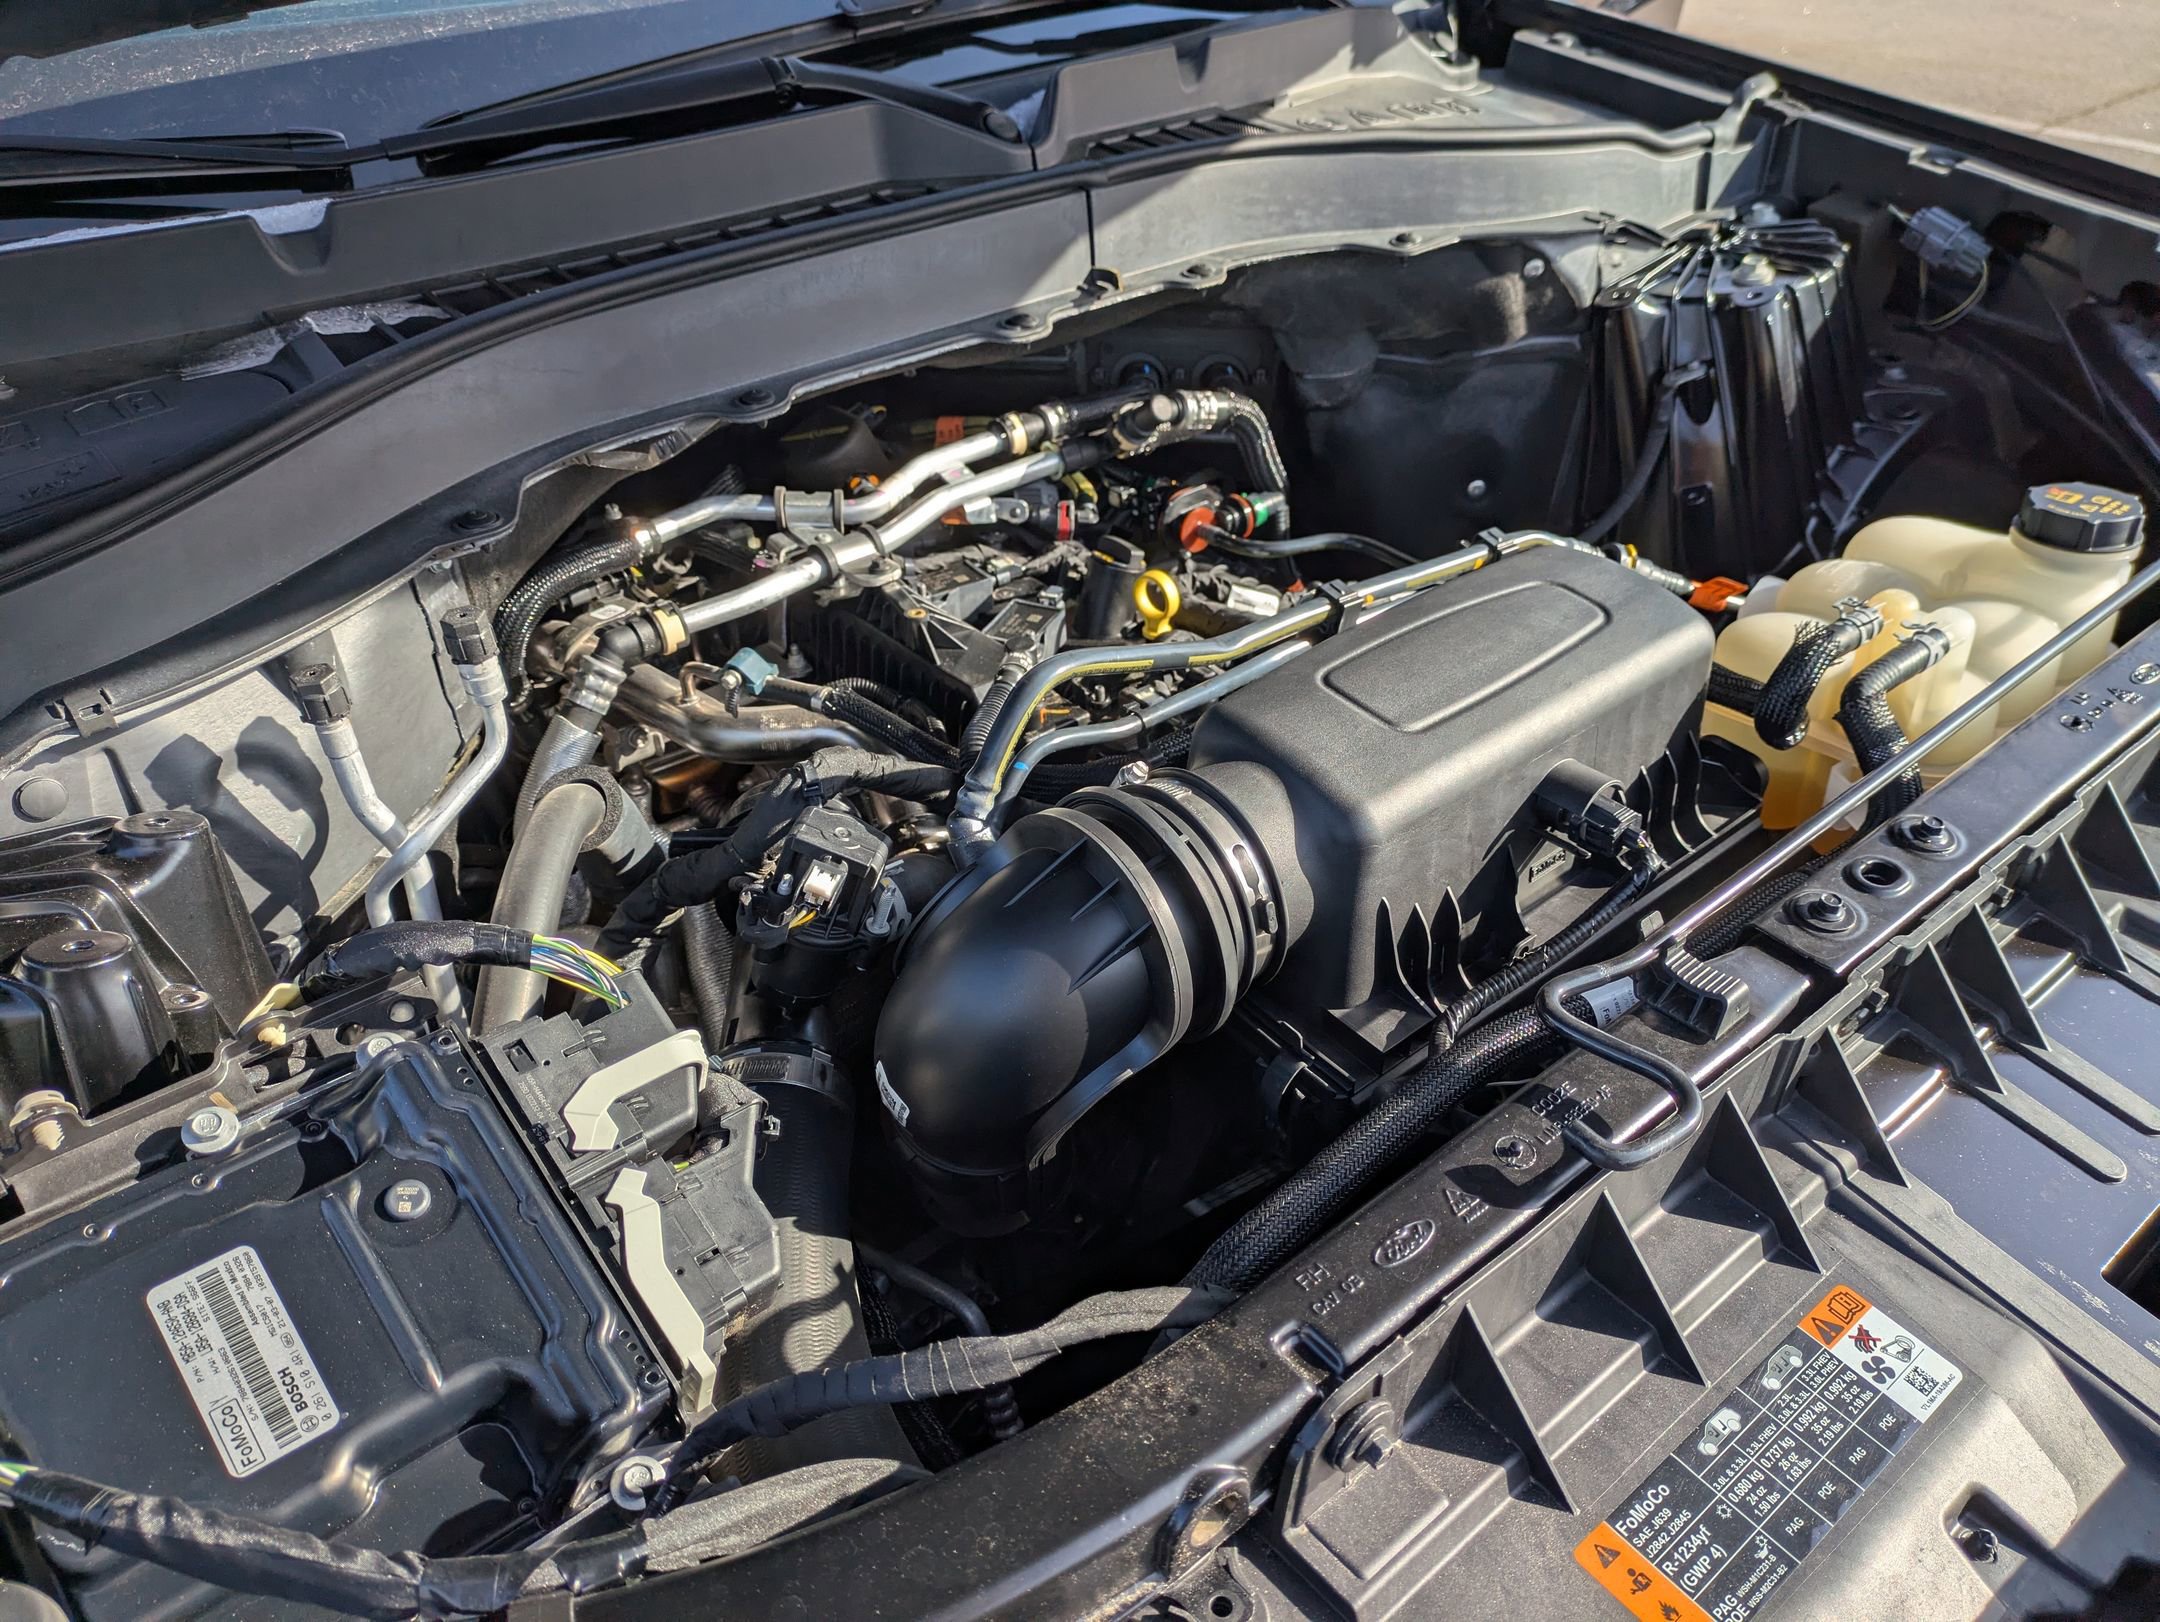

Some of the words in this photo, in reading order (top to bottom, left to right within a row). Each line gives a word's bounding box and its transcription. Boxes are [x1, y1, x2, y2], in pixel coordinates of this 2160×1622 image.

[220, 1259, 238, 1284] Mexico
[236, 1290, 259, 1327] Assembled
[1801, 1366, 1817, 1382] 3.3L
[1812, 1351, 1831, 1370] FHEV
[1809, 1373, 1825, 1389] 3.0L
[1820, 1357, 1840, 1376] PHEV
[276, 1365, 308, 1413] BOSCH
[1822, 1377, 1847, 1401] 0.992
[1840, 1369, 1858, 1383] kg
[1840, 1390, 1854, 1403] 35
[1849, 1384, 1860, 1395] oz
[1847, 1397, 1865, 1414] 2.19
[1858, 1388, 1874, 1402] lbs
[1777, 1406, 1794, 1422] 3.0L
[1789, 1400, 1799, 1409] &
[1794, 1388, 1811, 1404] 3.3L
[1792, 1408, 1817, 1432] 0.992
[1809, 1400, 1828, 1414] kg
[216, 1404, 258, 1467] FoMoCo
[1810, 1422, 1823, 1435] 35
[1819, 1415, 1831, 1427] oz
[1817, 1429, 1835, 1447] 2.19
[1829, 1419, 1844, 1434] lbs
[1878, 1412, 1897, 1431] POE
[1745, 1438, 1762, 1455] 3.3L
[1758, 1422, 1777, 1442] FHEV
[1759, 1443, 1784, 1469] 0.737
[1778, 1435, 1796, 1449] kg
[1848, 1445, 1867, 1464] PAG
[1712, 1473, 1729, 1490] 3.0L
[1724, 1467, 1735, 1477] &
[1730, 1454, 1747, 1471] 3.3L
[1777, 1457, 1791, 1470] 26
[1787, 1451, 1799, 1462] oz
[1785, 1465, 1803, 1483] 1.63
[1796, 1455, 1812, 1470] lbs
[1727, 1477, 1753, 1503] 0.680
[1746, 1468, 1765, 1483] kg
[1745, 1492, 1759, 1505] 24
[1755, 1484, 1767, 1497] oz
[1817, 1480, 1836, 1499] POE
[1614, 1482, 1671, 1536] FoMoCo
[1753, 1499, 1771, 1518] 1.50
[1765, 1489, 1781, 1504] lbs
[1632, 1525, 1654, 1548] SAE
[1649, 1506, 1672, 1529] J639
[1644, 1531, 1671, 1558] J2842
[1665, 1508, 1692, 1535] J2845
[1784, 1515, 1805, 1536] PAG
[1661, 1523, 1714, 1576] R-1234yf
[1678, 1554, 1716, 1594] (GWP
[1706, 1542, 1729, 1560] 4)
[1712, 1593, 1738, 1620] PAG
